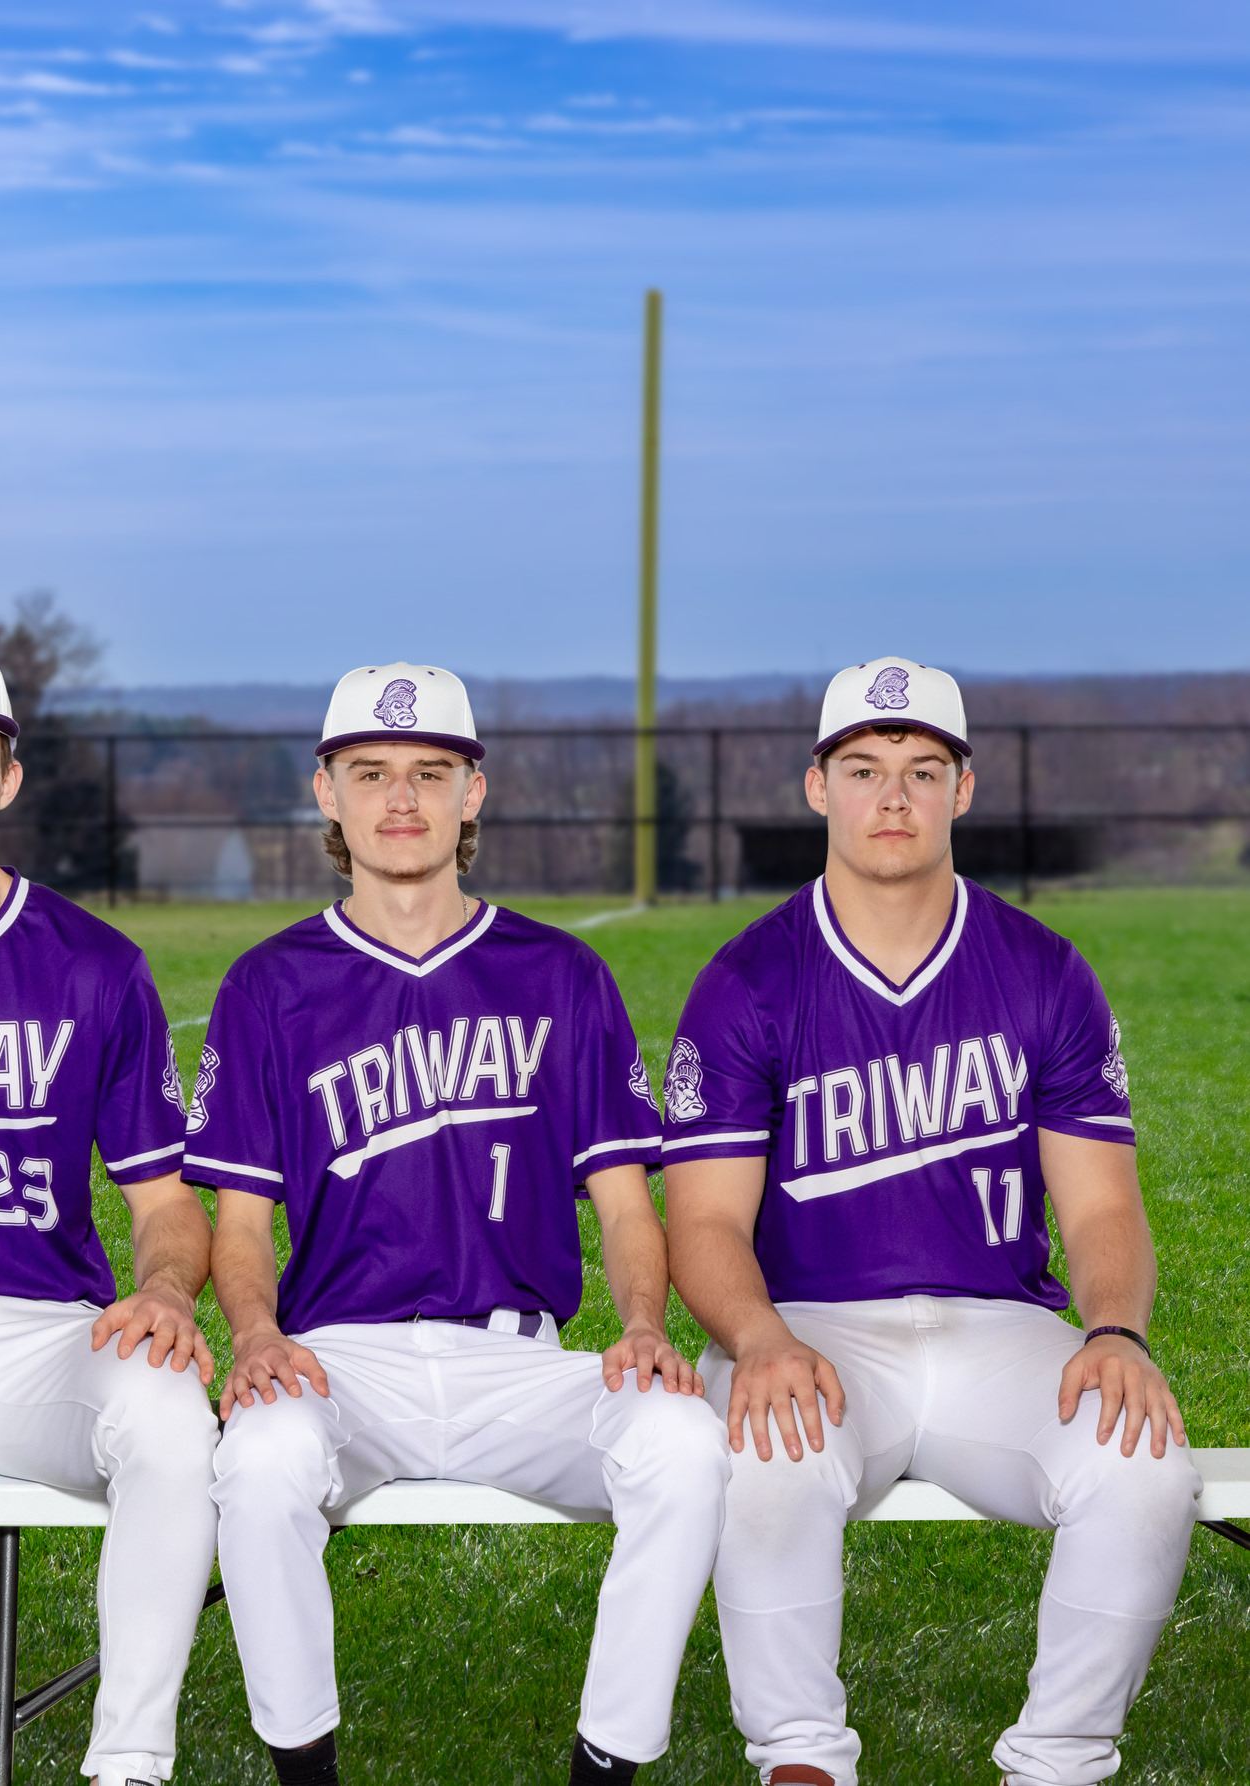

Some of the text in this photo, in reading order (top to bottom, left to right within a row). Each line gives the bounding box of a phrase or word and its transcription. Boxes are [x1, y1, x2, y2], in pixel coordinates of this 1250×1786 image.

[308, 1017, 552, 1149] TRIWAY
[787, 1033, 1029, 1168] TRIWAY
[488, 1143, 511, 1221] 1
[971, 1168, 1023, 1246] 11
